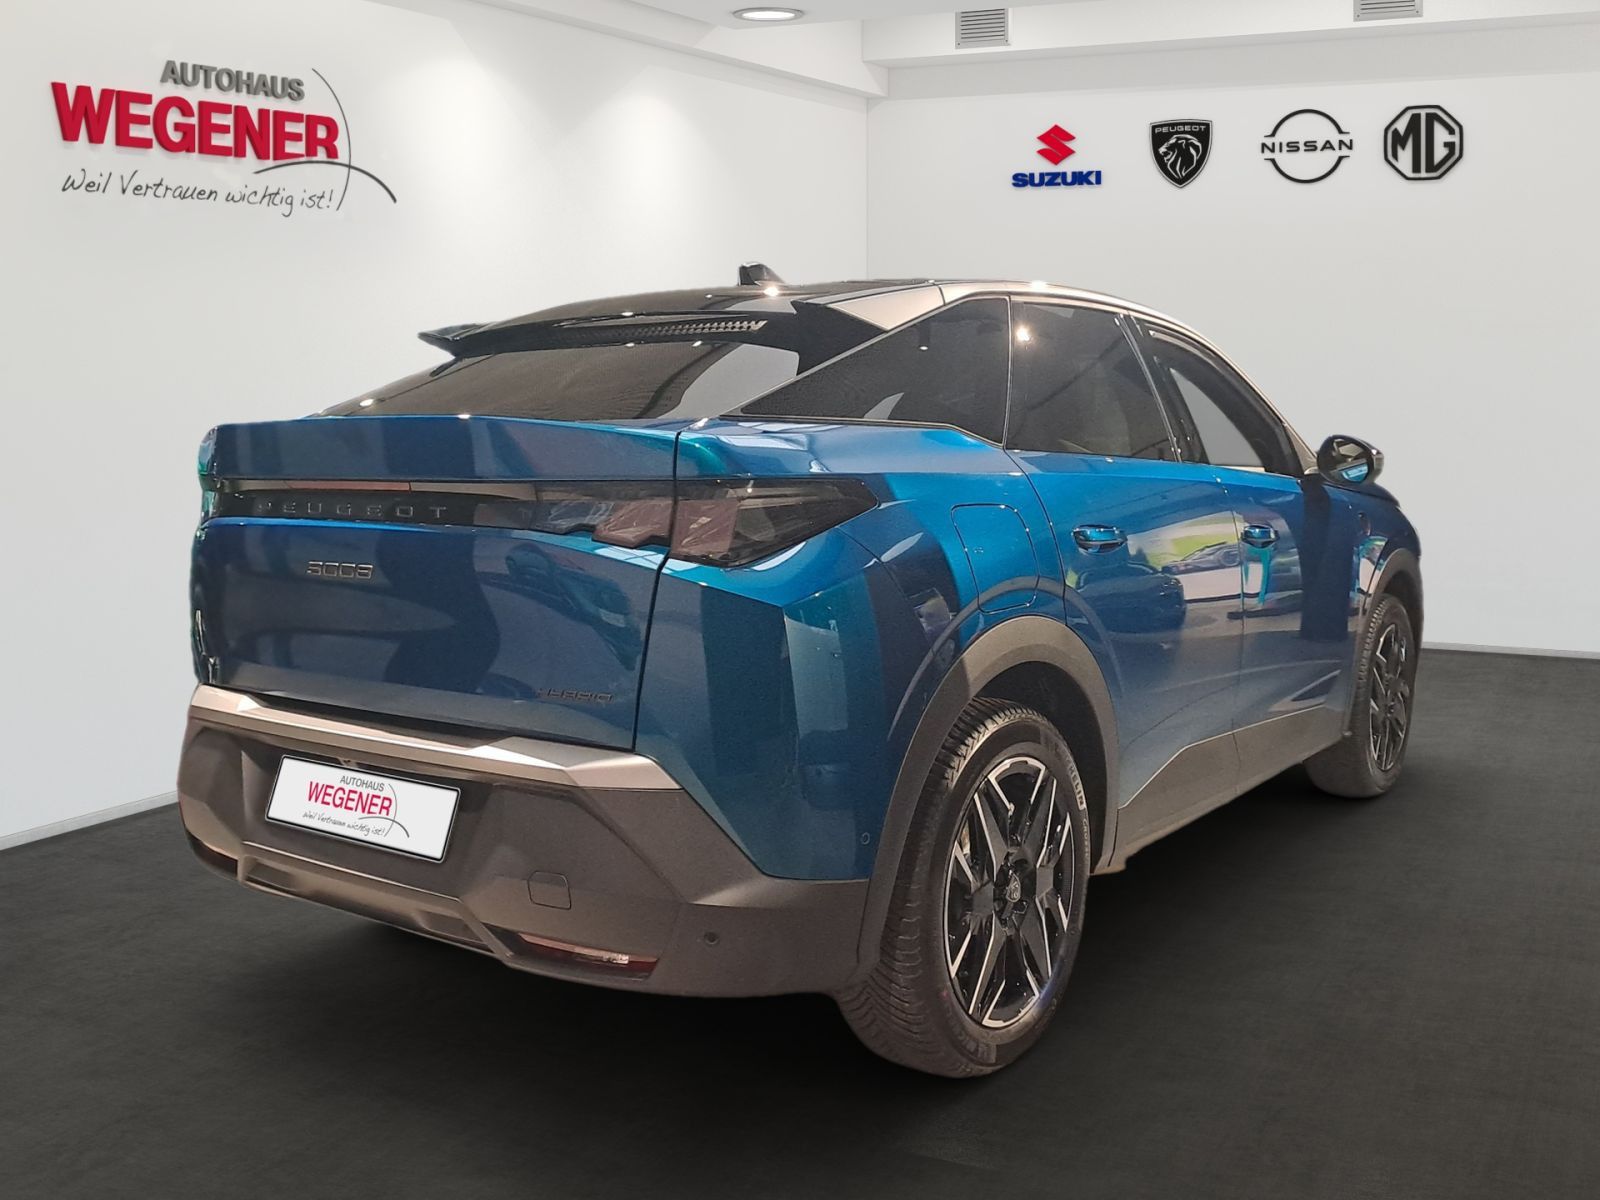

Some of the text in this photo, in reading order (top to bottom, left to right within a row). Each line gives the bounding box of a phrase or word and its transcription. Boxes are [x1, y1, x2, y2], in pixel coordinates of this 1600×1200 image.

[160, 60, 305, 101] AUTOHAUS
[51, 81, 340, 161] WEGENER
[1154, 125, 1207, 133] PEUGEOT
[1261, 139, 1353, 154] NISSAN
[1391, 112, 1456, 174] MG
[61, 168, 112, 193] Weil
[119, 169, 218, 202] Vertrauen
[225, 184, 294, 218] wichtig
[1012, 171, 1102, 188] SUZUKI
[308, 781, 393, 816] WEGENER
[340, 775, 385, 792] AUTOHAUS
